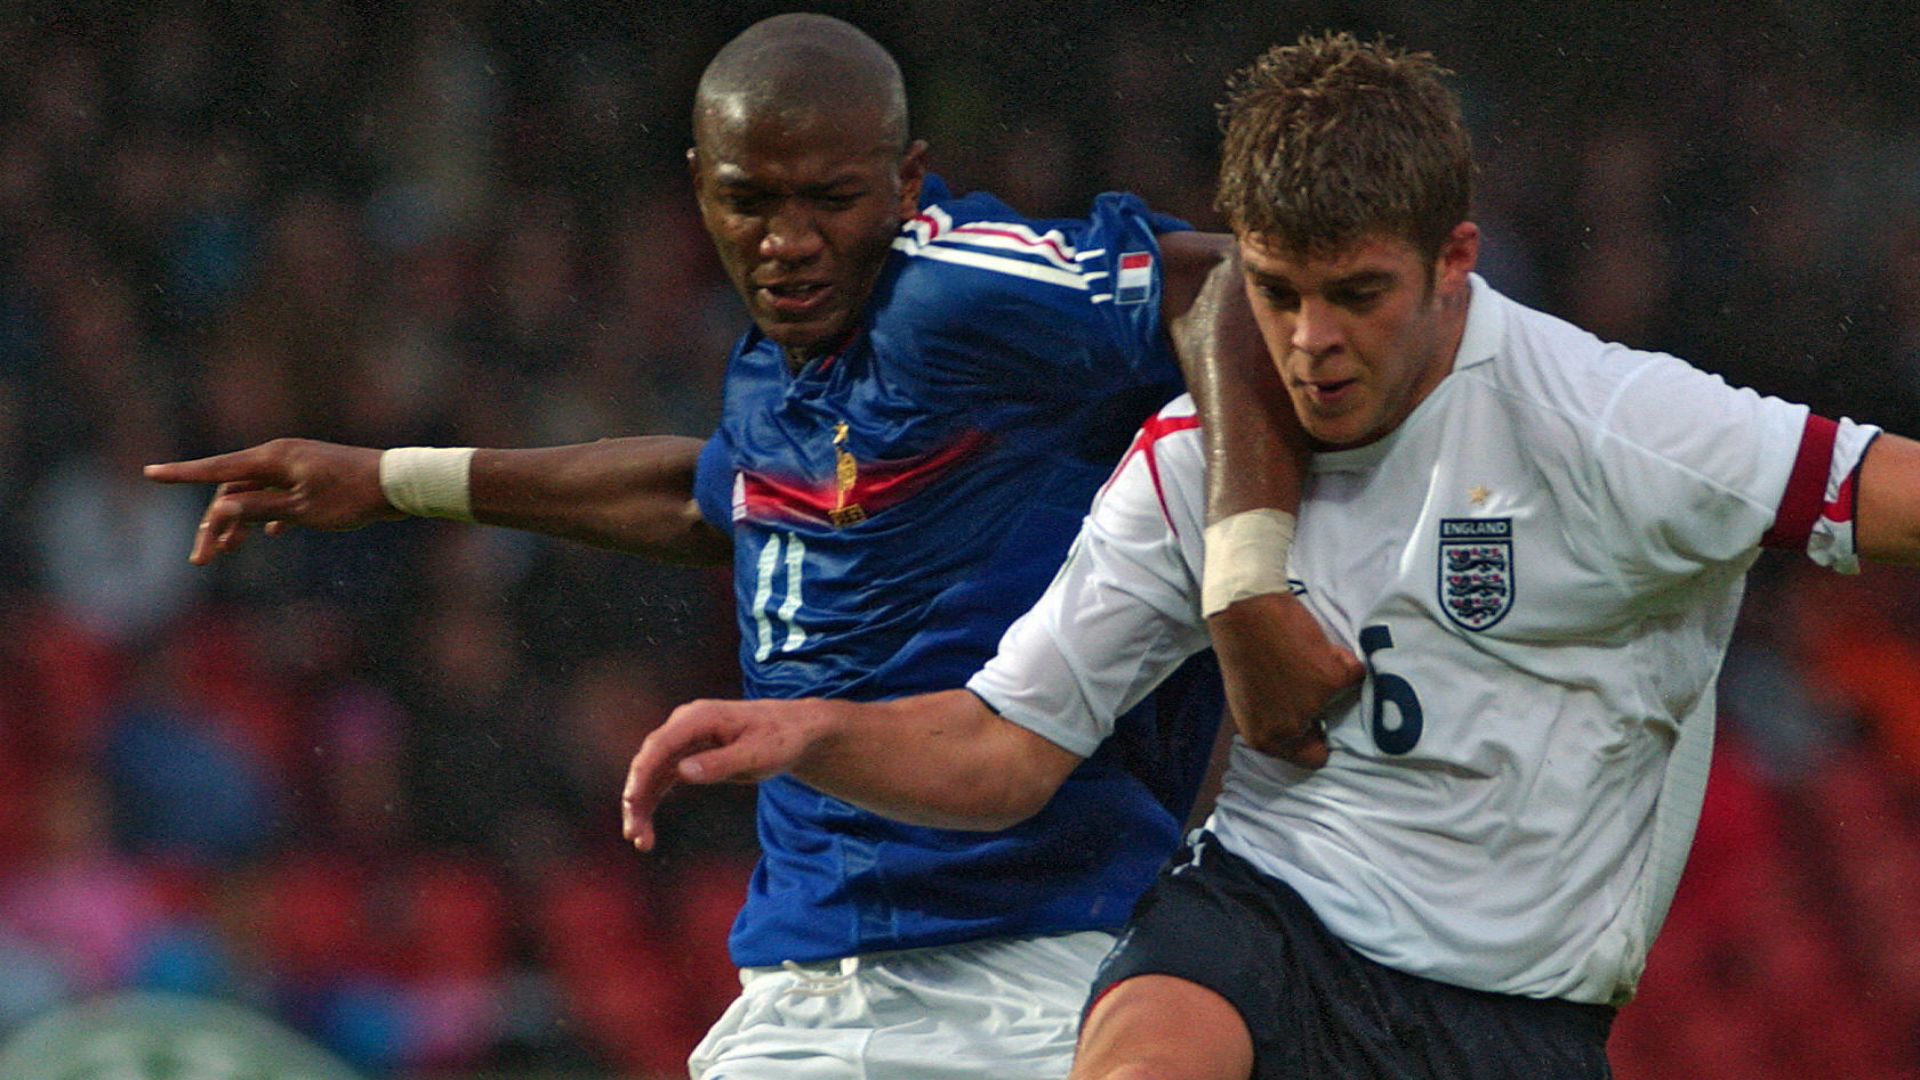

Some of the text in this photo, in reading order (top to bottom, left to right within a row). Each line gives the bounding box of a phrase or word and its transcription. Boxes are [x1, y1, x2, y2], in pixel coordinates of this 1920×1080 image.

[1443, 521, 1508, 535] ENGLAND
[753, 532, 807, 663] 11
[1359, 624, 1424, 756] 6
